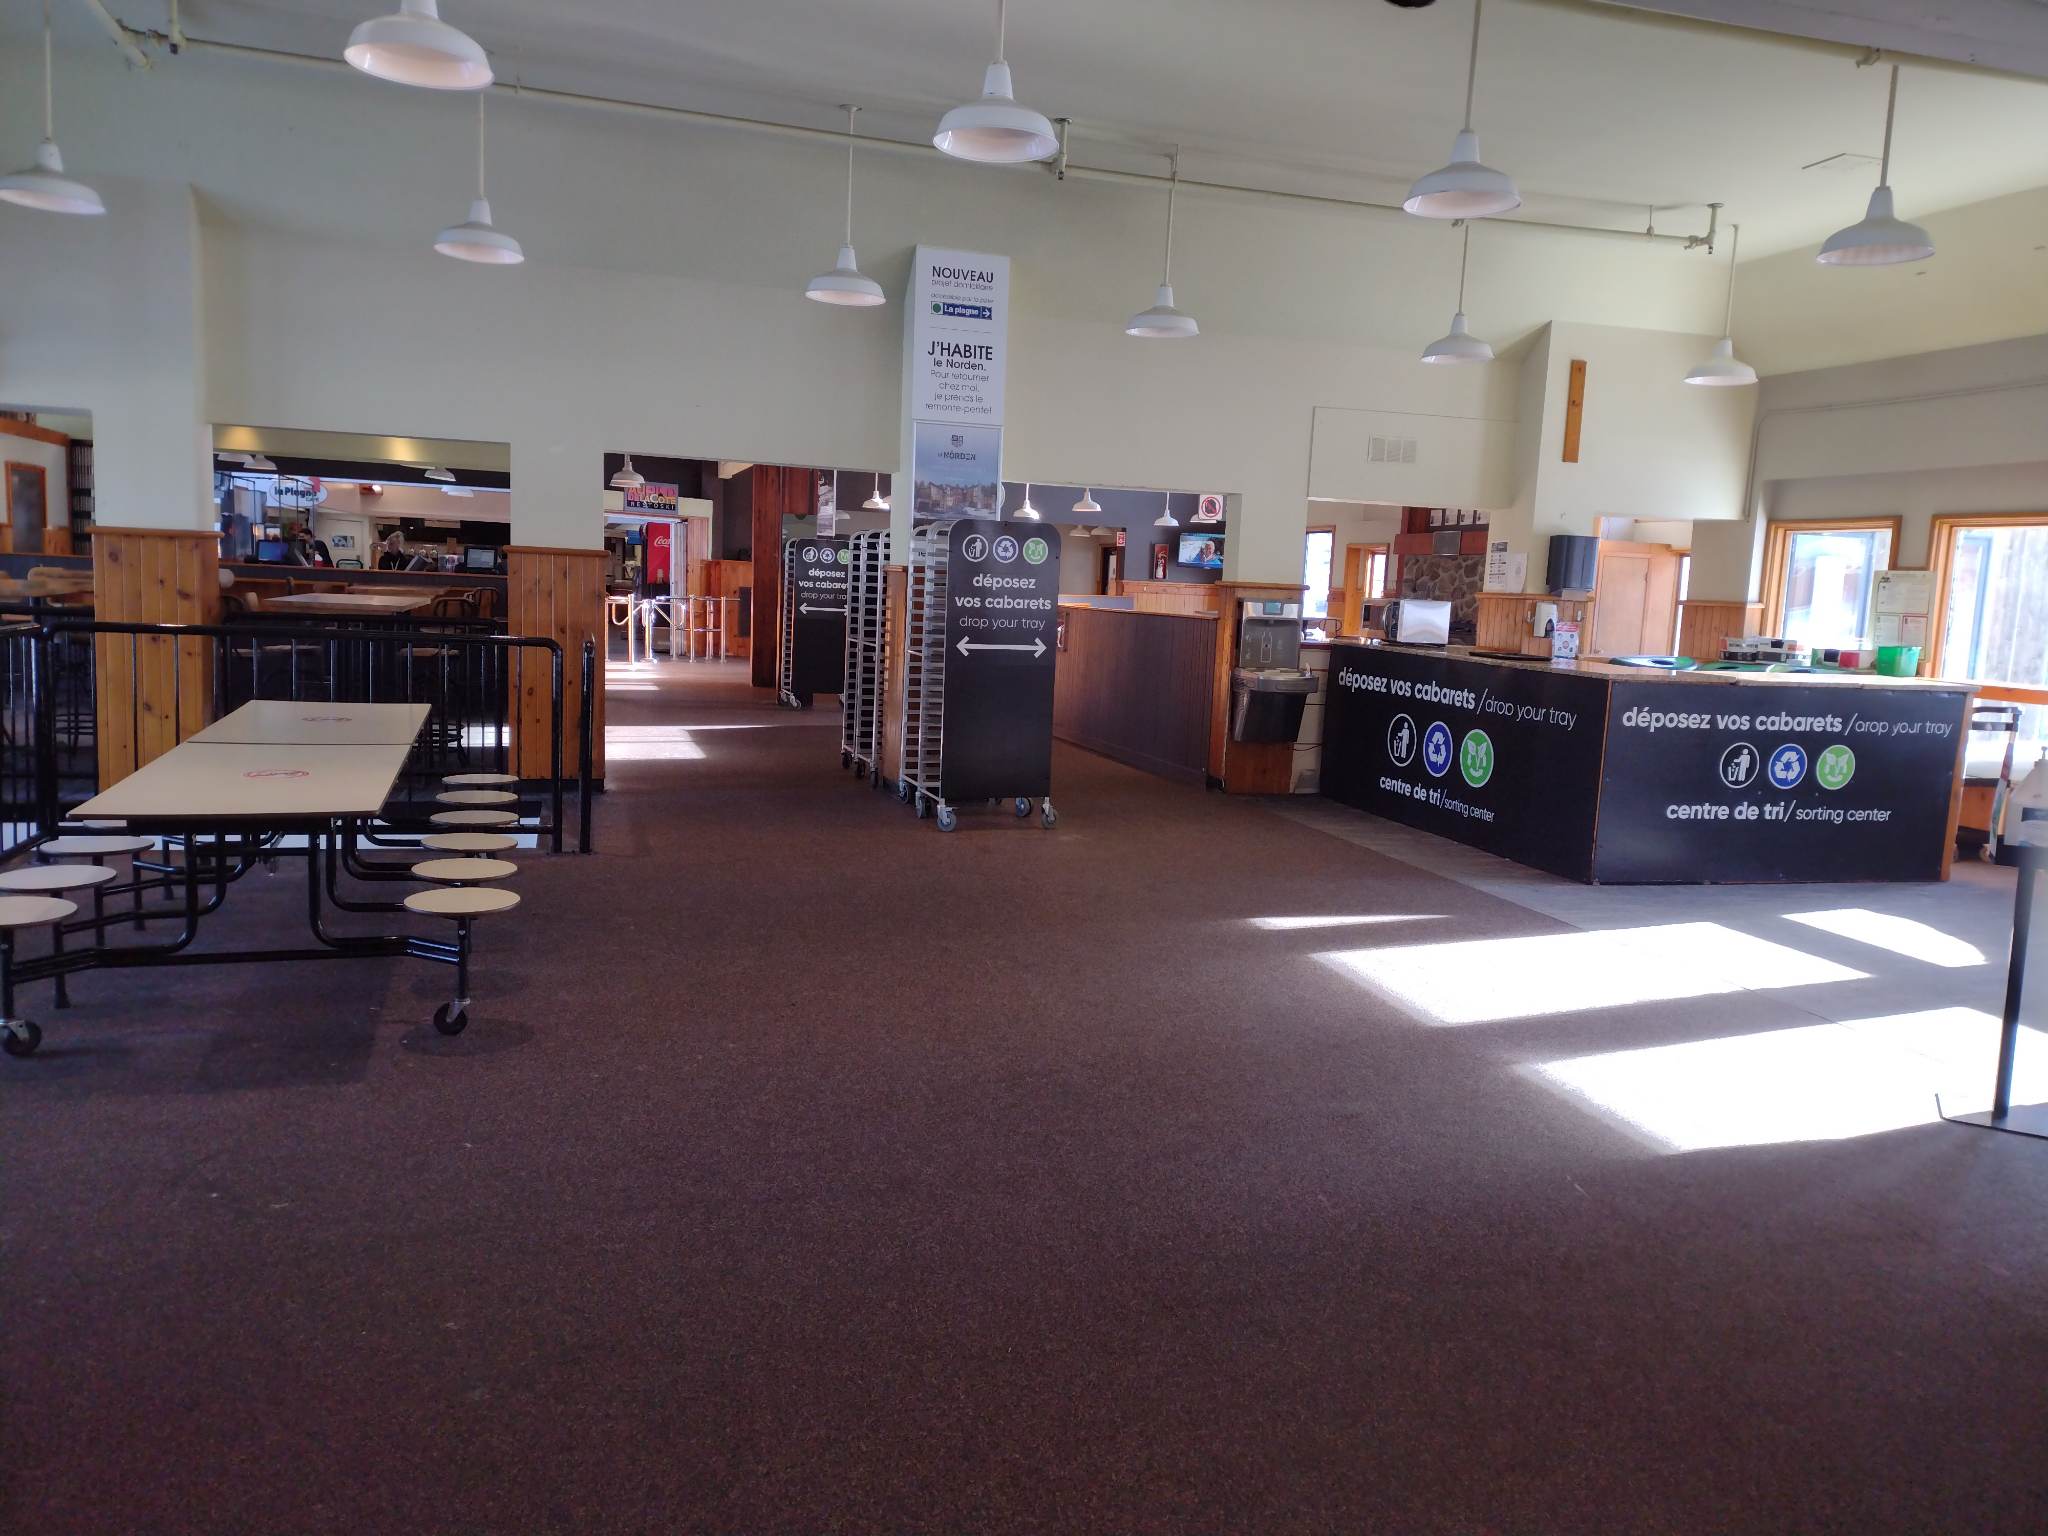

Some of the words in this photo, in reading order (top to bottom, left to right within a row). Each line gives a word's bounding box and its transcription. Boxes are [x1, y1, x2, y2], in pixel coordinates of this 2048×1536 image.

[932, 265, 994, 283] NOUVEAU
[933, 358, 942, 367] le
[946, 359, 986, 371] Norden.
[931, 369, 949, 379] Pour
[952, 372, 989, 381] retourner
[939, 382, 960, 391] chez
[934, 392, 942, 401] je
[808, 568, 846, 579] déposez
[798, 580, 814, 588] vos
[973, 573, 1036, 590] déposez
[800, 591, 818, 599] drop
[955, 596, 981, 608] vos
[985, 595, 1052, 610] cabarets
[959, 616, 989, 629] drop
[992, 618, 1018, 630] your
[1021, 618, 1046, 631] tray
[1338, 666, 1388, 693] déposez
[1390, 678, 1411, 697] vos
[1415, 680, 1476, 710] cabarets
[1516, 704, 1546, 721] your
[1549, 706, 1577, 731] tray
[1622, 706, 1711, 732] déposez
[1716, 714, 1750, 731] vos
[1755, 711, 1843, 733] cabarets
[1892, 721, 1922, 737] your
[1925, 720, 1953, 738] tray
[1379, 776, 1412, 796] centre
[1413, 782, 1427, 801] de
[1469, 805, 1495, 822] center
[1666, 802, 1730, 820] centre
[1734, 801, 1759, 820] de
[1847, 806, 1891, 822] center
